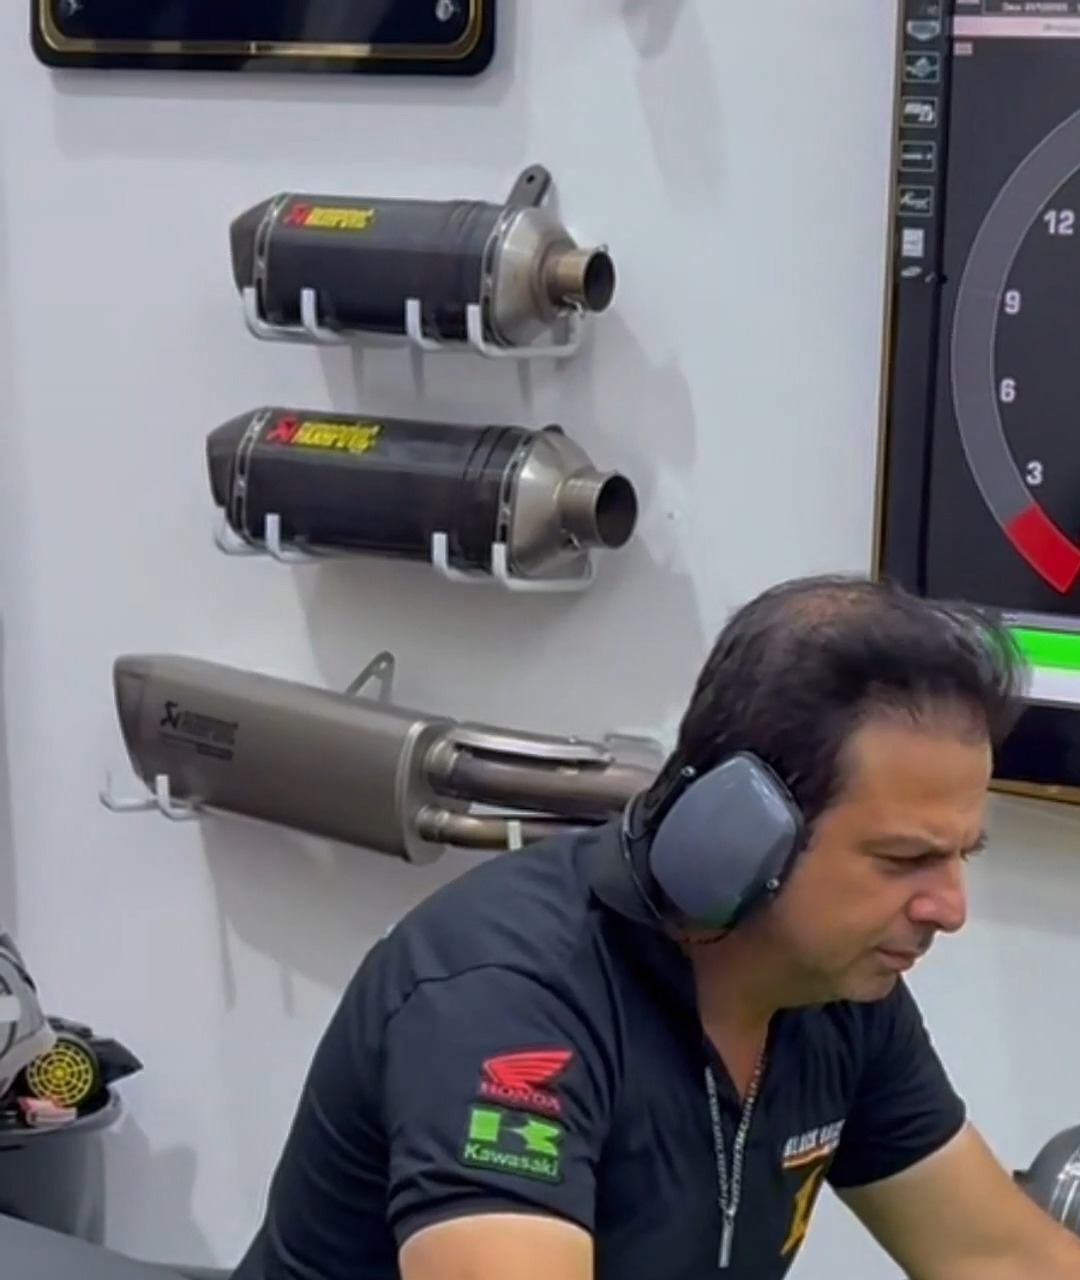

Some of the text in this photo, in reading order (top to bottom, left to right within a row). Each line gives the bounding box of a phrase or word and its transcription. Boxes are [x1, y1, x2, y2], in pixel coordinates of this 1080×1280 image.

[1044, 211, 1074, 235] 12
[1004, 291, 1020, 314] 9
[1000, 379, 1016, 402] 6
[1027, 462, 1043, 485] 3
[478, 1081, 562, 1113] HONDA
[464, 1142, 559, 1177] Kawasaki
